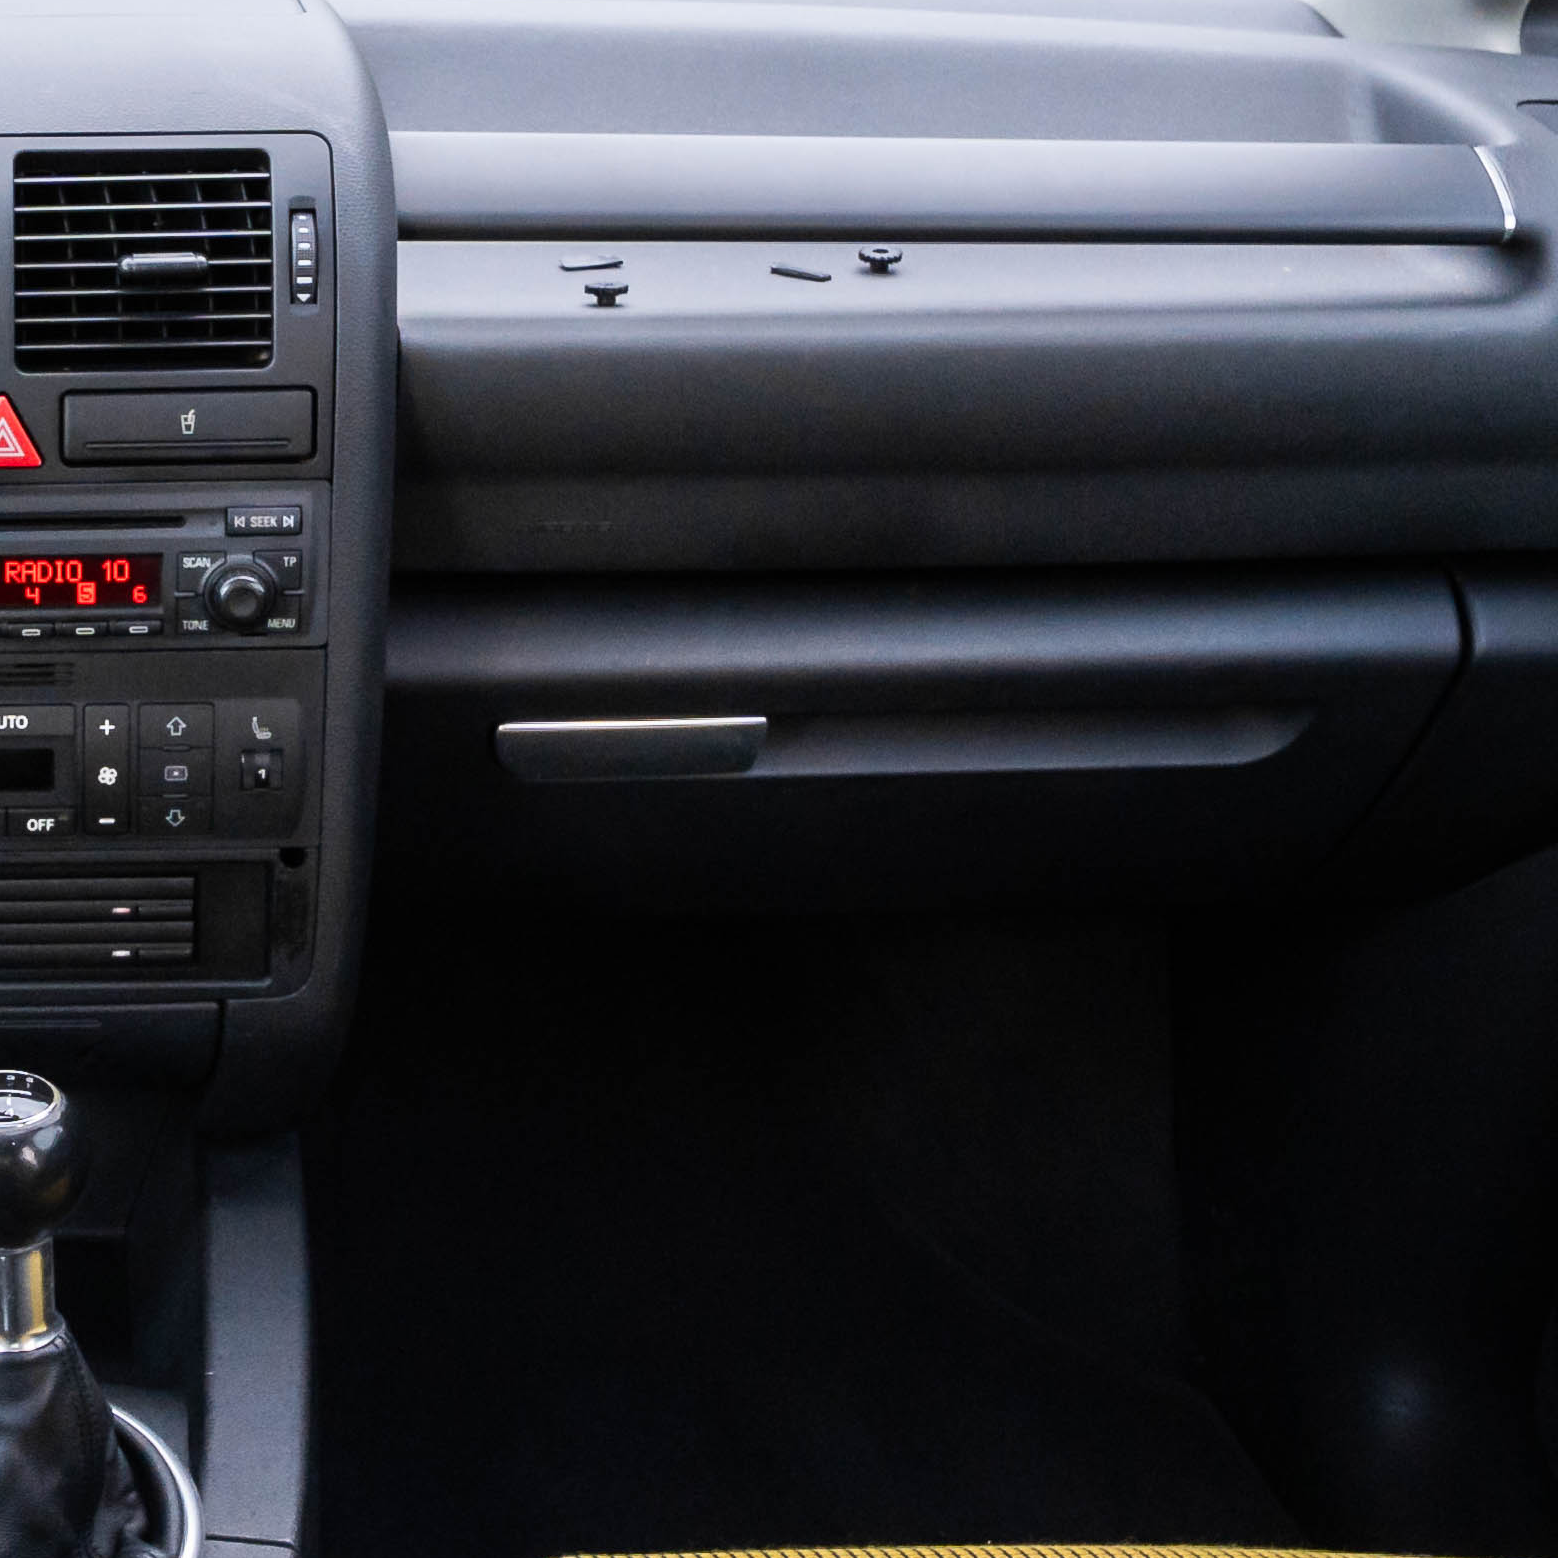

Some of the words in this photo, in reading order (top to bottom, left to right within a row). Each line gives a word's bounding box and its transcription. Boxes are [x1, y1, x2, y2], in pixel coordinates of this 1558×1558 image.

[249, 515, 278, 528] SEEK
[182, 556, 212, 569] SCAN
[283, 556, 297, 568] TP
[4, 558, 83, 584] RADIO
[101, 559, 130, 582] 10
[24, 585, 40, 605] 4
[132, 585, 148, 604] 6
[182, 618, 209, 631] TONE
[267, 617, 297, 630] MENU
[26, 818, 55, 832] OFF
